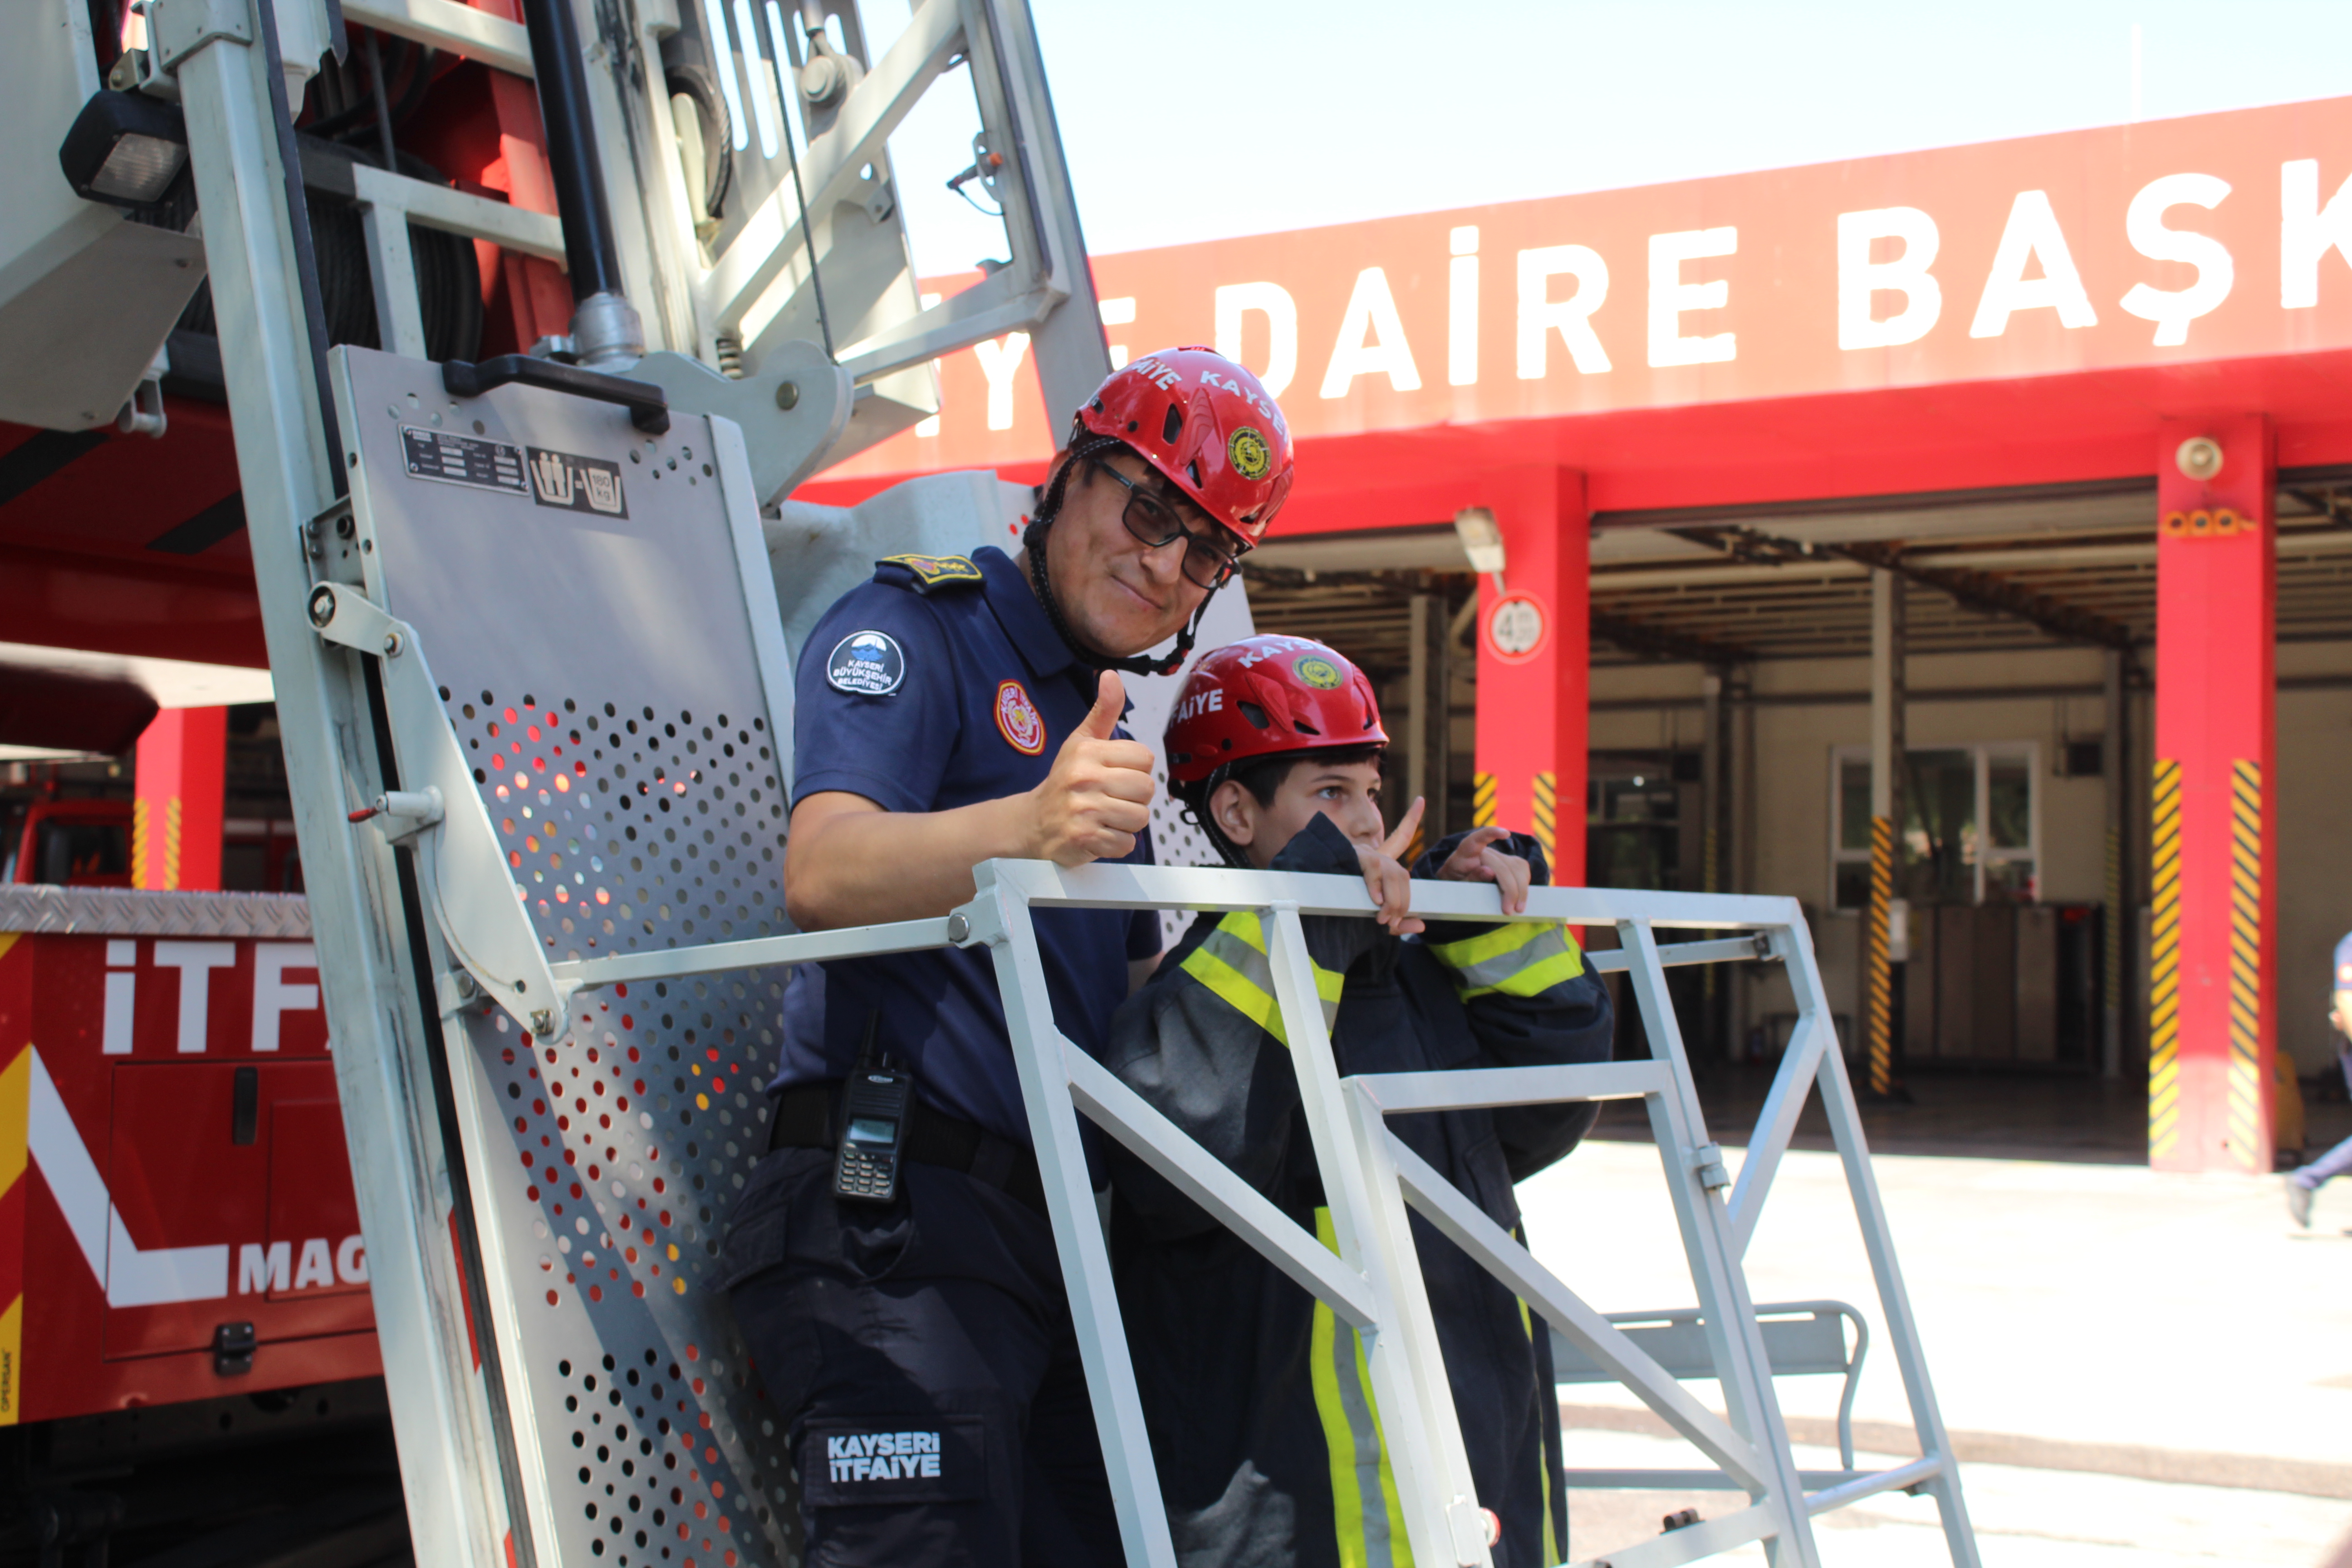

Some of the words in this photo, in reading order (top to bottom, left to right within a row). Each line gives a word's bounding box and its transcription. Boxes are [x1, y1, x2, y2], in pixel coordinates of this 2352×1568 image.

[1214, 225, 1739, 399] DAİRE
[592, 474, 610, 487] 180
[596, 487, 611, 501] kg
[848, 659, 884, 672] KAYSERİ
[833, 666, 892, 686] BÜYÜKŞEHİR
[838, 677, 883, 691] BELEDİYESİ
[102, 938, 333, 1055] İTF
[828, 1431, 941, 1460] KAYSERİ
[829, 1454, 941, 1483] İTFAİYE
